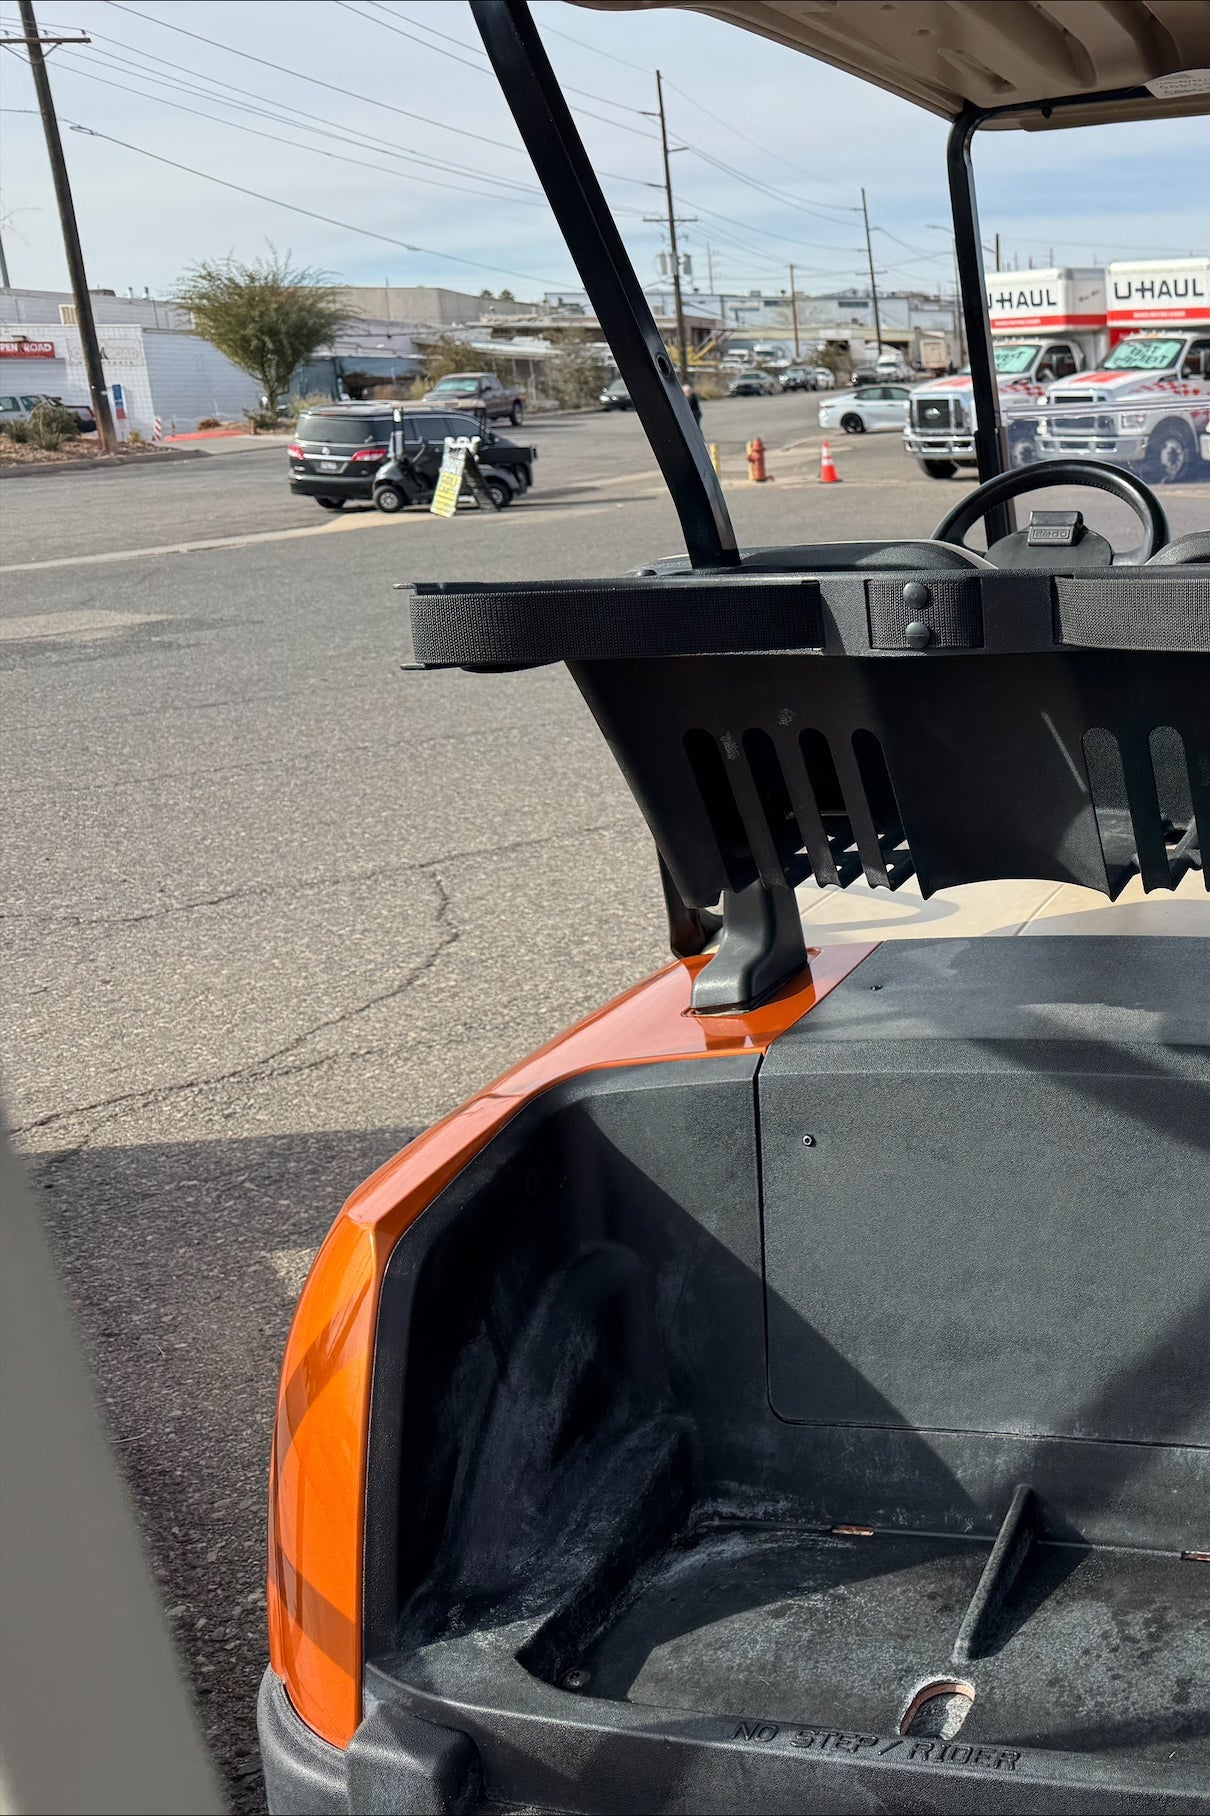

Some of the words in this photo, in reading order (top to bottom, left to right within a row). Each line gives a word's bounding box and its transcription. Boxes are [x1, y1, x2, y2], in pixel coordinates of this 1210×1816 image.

[1114, 278, 1204, 299] U-HAUL
[0, 342, 18, 352] PEN
[23, 342, 52, 352] ROAD
[731, 1721, 780, 1742] NO
[790, 1729, 880, 1753] STEP
[906, 1742, 1021, 1771] RIDER
